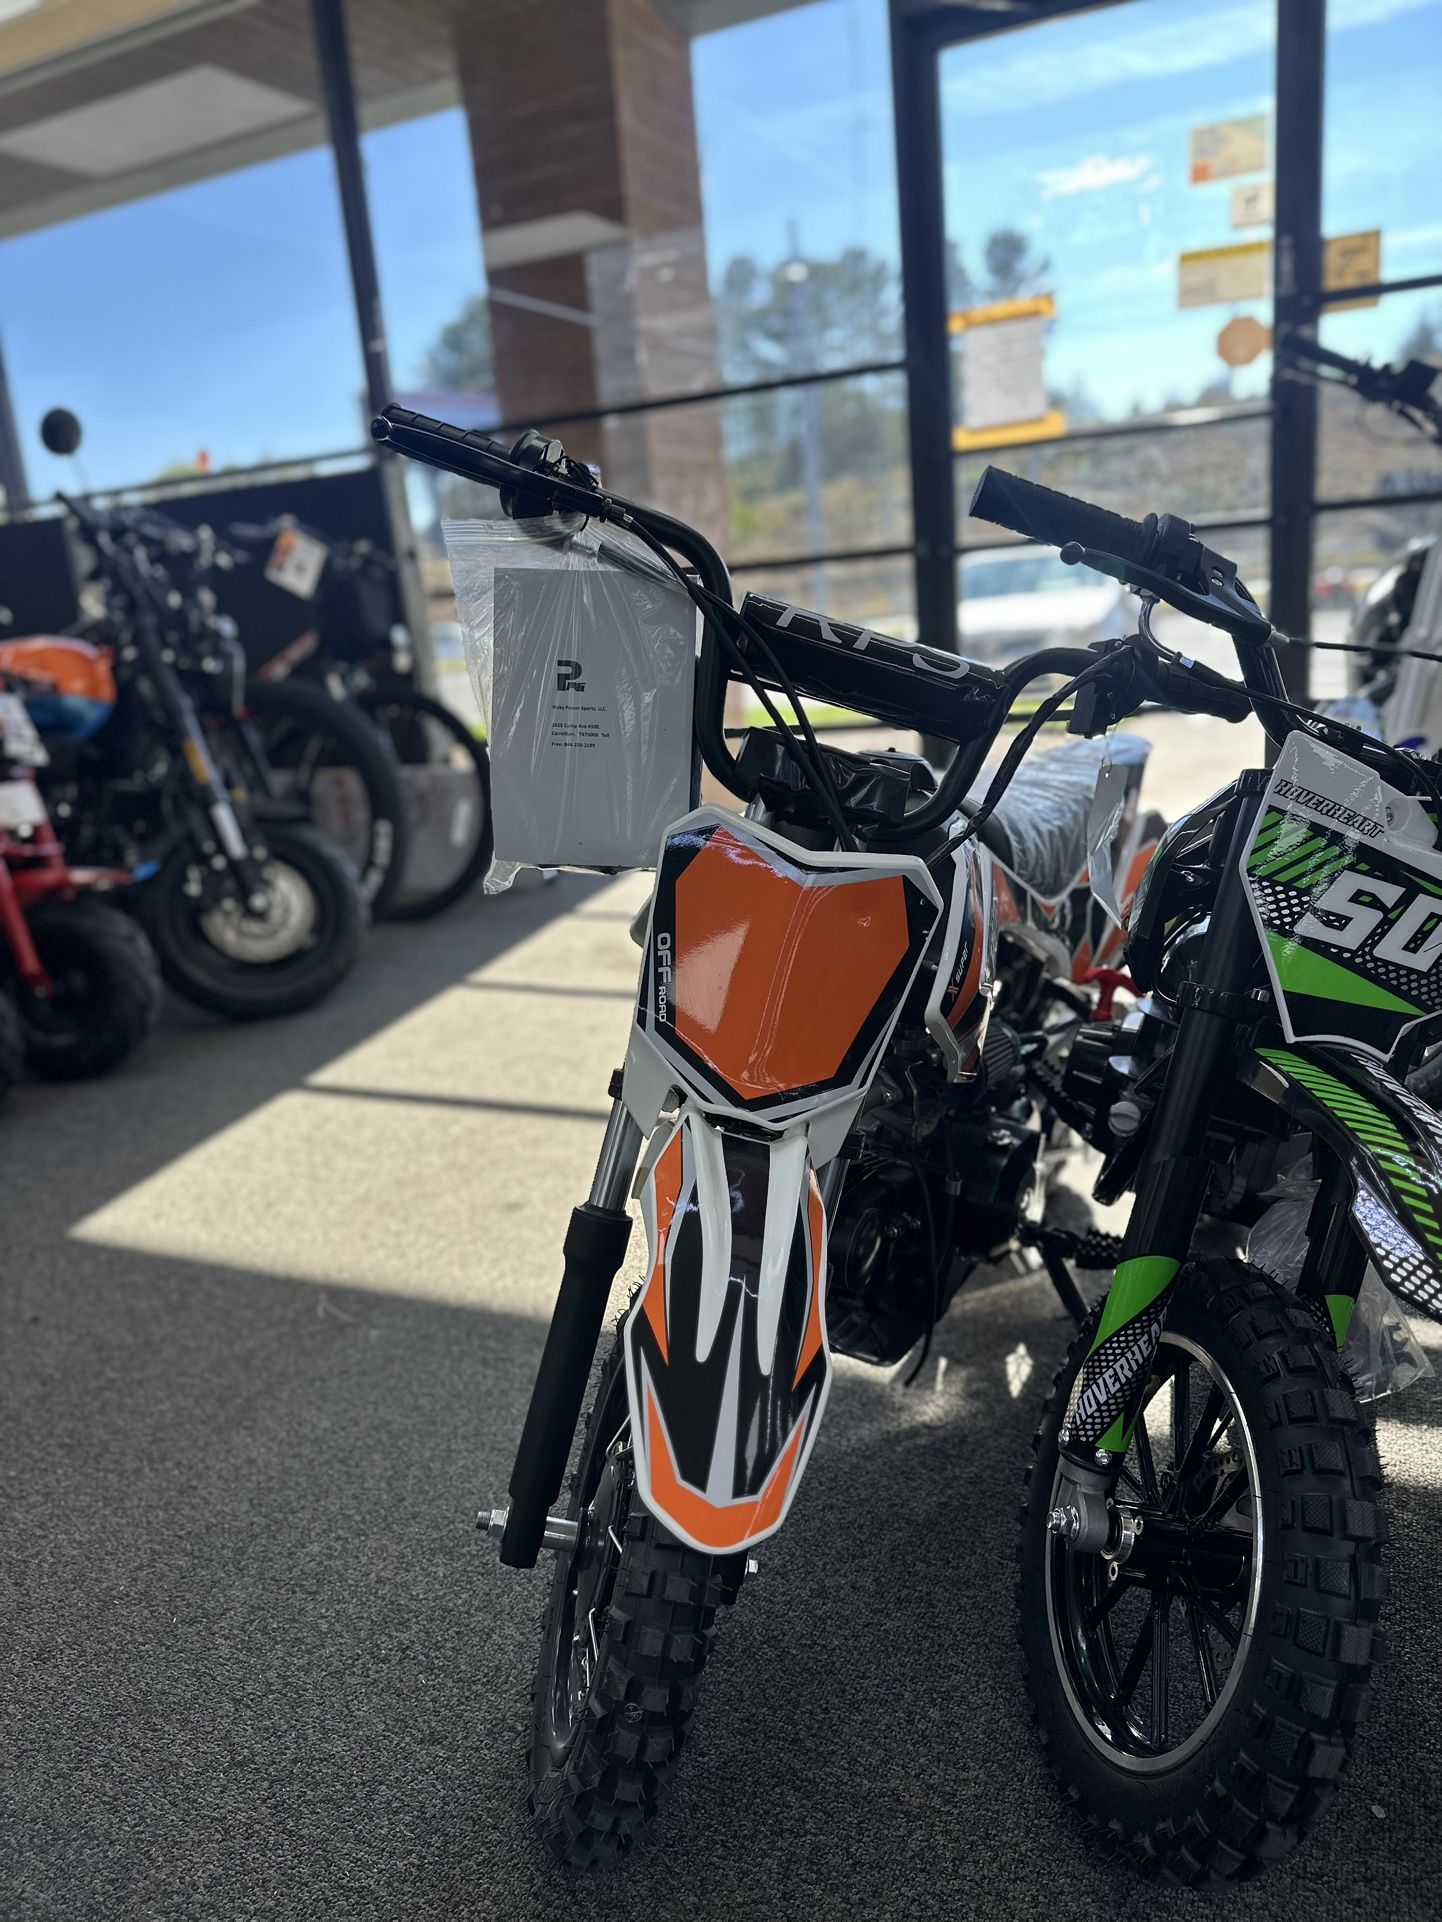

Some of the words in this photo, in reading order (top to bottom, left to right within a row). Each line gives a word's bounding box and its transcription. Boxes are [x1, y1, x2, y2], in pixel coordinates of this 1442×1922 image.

[1273, 779, 1385, 838] HOVERHEART
[657, 932, 672, 983] OFF
[658, 985, 667, 1023] ROAD
